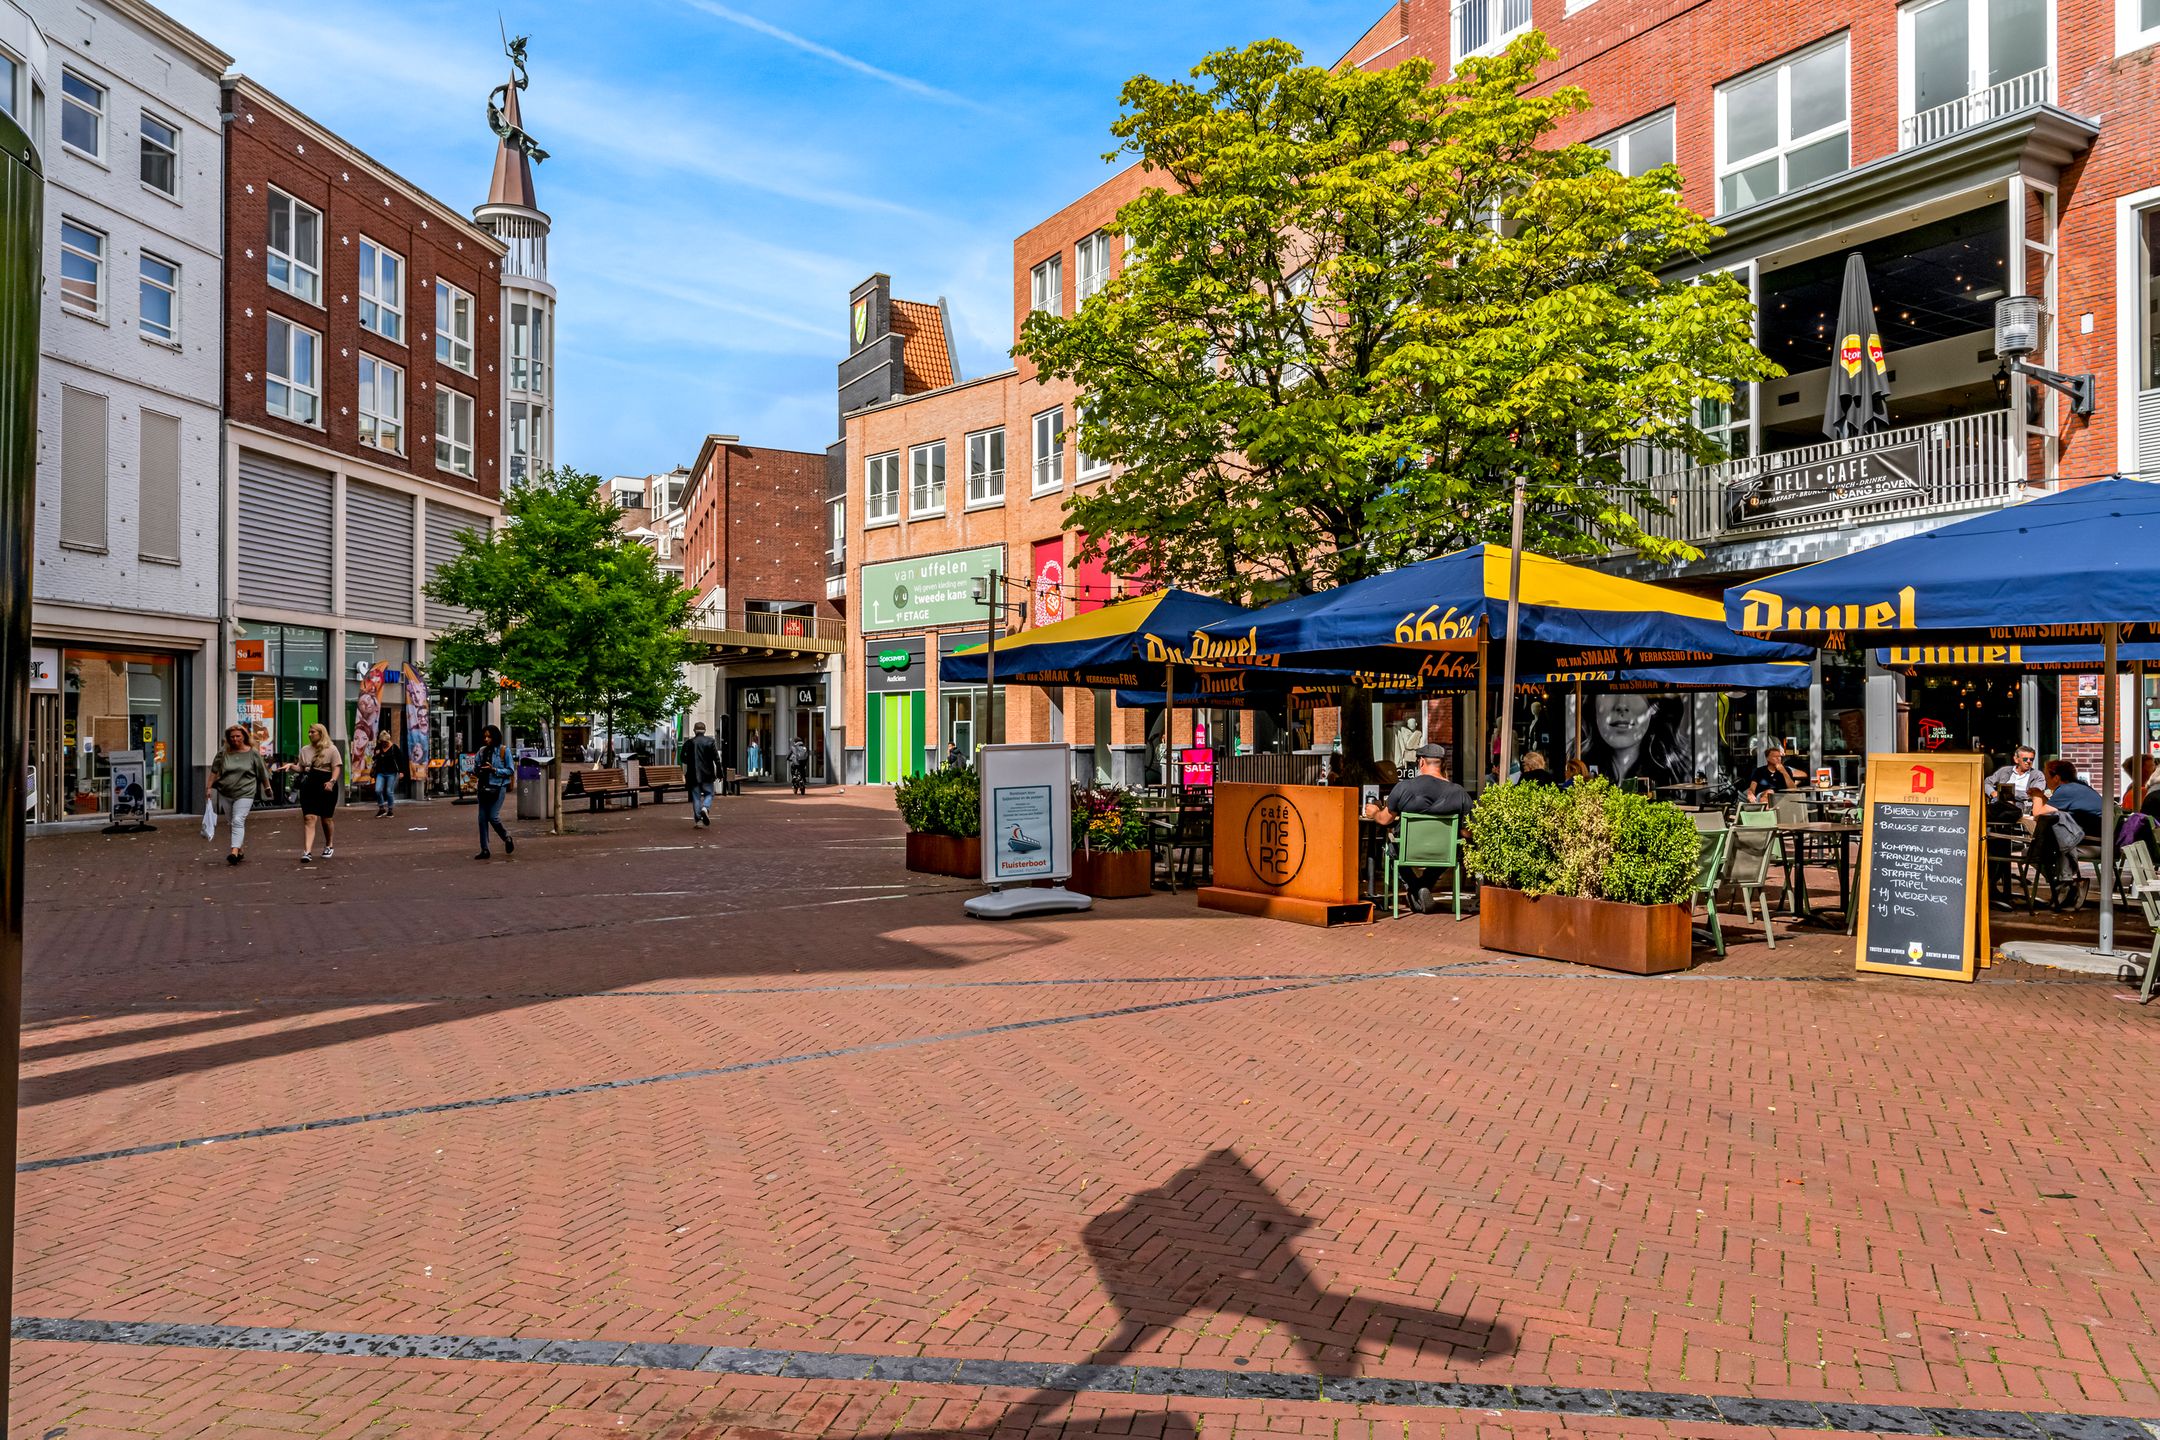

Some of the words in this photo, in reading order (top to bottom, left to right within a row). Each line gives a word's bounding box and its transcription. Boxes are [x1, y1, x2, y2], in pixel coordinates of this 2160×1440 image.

[1774, 470, 1809, 495] DELI
[1826, 458, 1868, 484] CAFE
[1858, 475, 1887, 487] DRINKS
[1829, 484, 1872, 502] INGANG
[1874, 478, 1912, 493] BOVEN
[894, 568, 914, 582] van
[920, 560, 968, 578] uffelen
[914, 592, 945, 605] tweede
[947, 590, 967, 600] kans
[904, 610, 930, 621] ETAGE
[1740, 585, 1918, 632] Duvel
[1990, 627, 2012, 639] VOL
[2014, 626, 2036, 638] VAN
[1191, 626, 1257, 660] Duvel
[879, 654, 906, 663] Specsavers
[1556, 658, 1568, 668] VOL
[1569, 656, 1582, 667] VAN
[1581, 648, 1618, 666] SMAAK
[1639, 652, 1686, 662] VERRASSEND
[1039, 670, 1070, 682] SMAAK
[1086, 674, 1120, 685] VERRASSEND
[1120, 673, 1138, 686] FRIS
[1184, 764, 1211, 772] SALE
[1260, 806, 1288, 819] café
[1880, 804, 1920, 816] BIEREN
[1880, 820, 1920, 832] BRUGSE
[1938, 826, 1966, 834] BLOND
[1881, 842, 1924, 853] KOMPAAN
[1926, 847, 1952, 856] WHITE
[1952, 848, 1966, 856] IPA
[1002, 860, 1046, 869] Fluisterboot
[1881, 868, 1922, 880] STRAFFE
[1925, 873, 1963, 886] HENDRIK
[1890, 880, 1928, 890] TRIPEL
